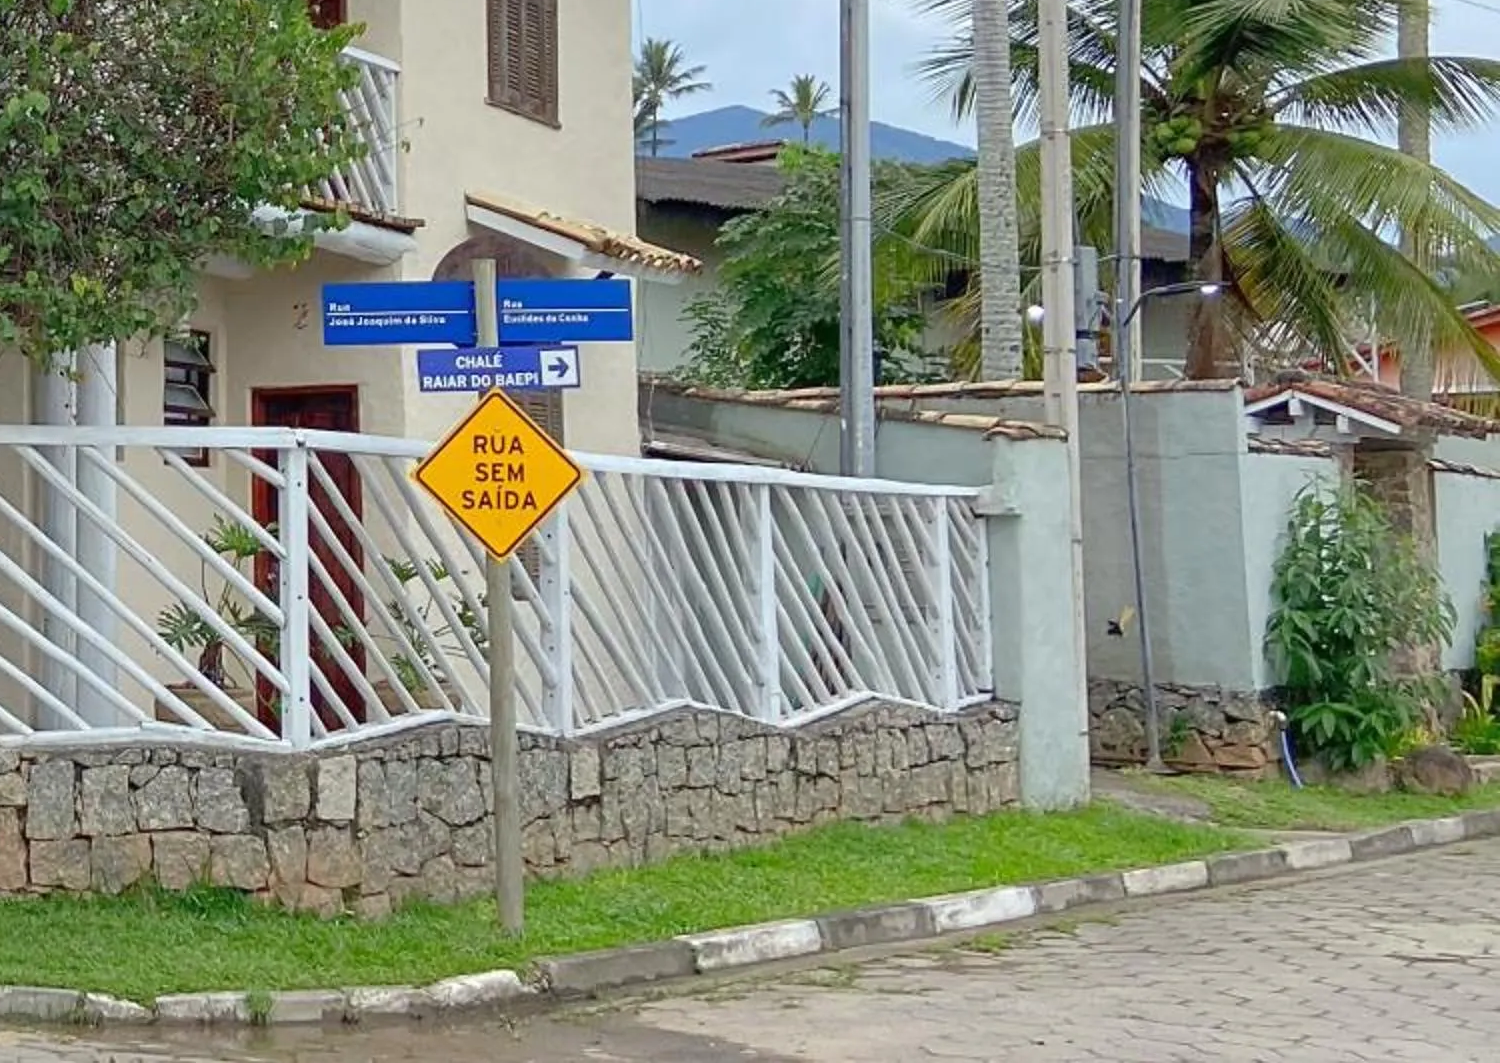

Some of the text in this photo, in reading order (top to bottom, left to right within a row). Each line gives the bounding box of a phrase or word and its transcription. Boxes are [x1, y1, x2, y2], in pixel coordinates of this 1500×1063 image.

[503, 300, 523, 308] Rua
[419, 315, 446, 325] Silva
[455, 353, 503, 369] CHALÉ
[423, 372, 539, 388] RAIAR DO BAEPI
[473, 435, 524, 454] RUA
[475, 462, 525, 482] SEM
[461, 485, 538, 510] SAÍDA
